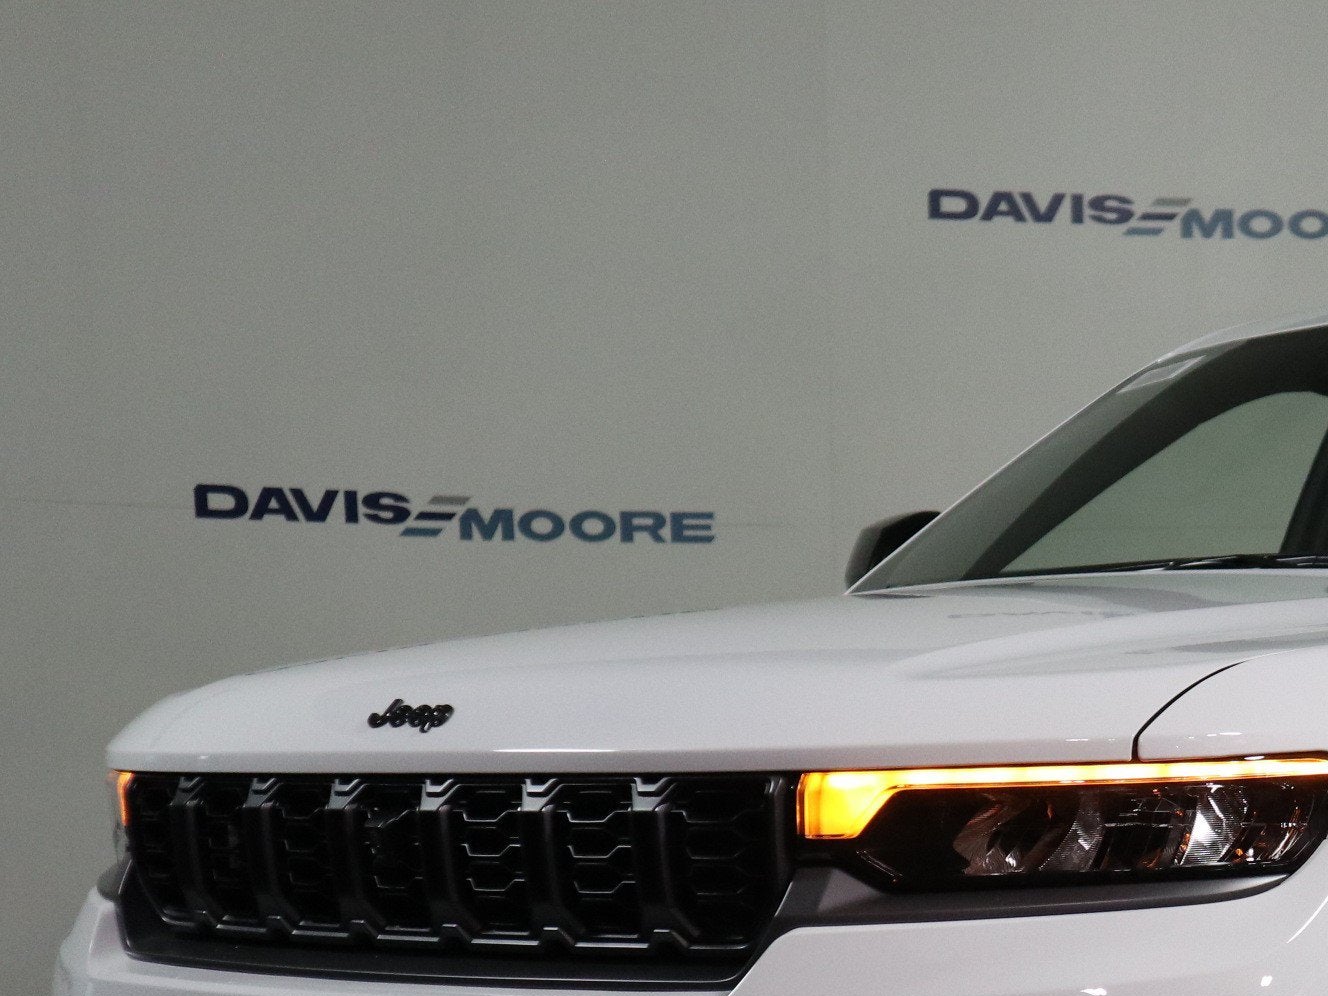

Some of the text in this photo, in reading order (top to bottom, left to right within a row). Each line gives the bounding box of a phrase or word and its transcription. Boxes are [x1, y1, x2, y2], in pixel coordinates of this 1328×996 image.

[927, 187, 1135, 225] DAVIS
[193, 483, 716, 544] DAVIS MOORE
[367, 698, 455, 734] Jeep
